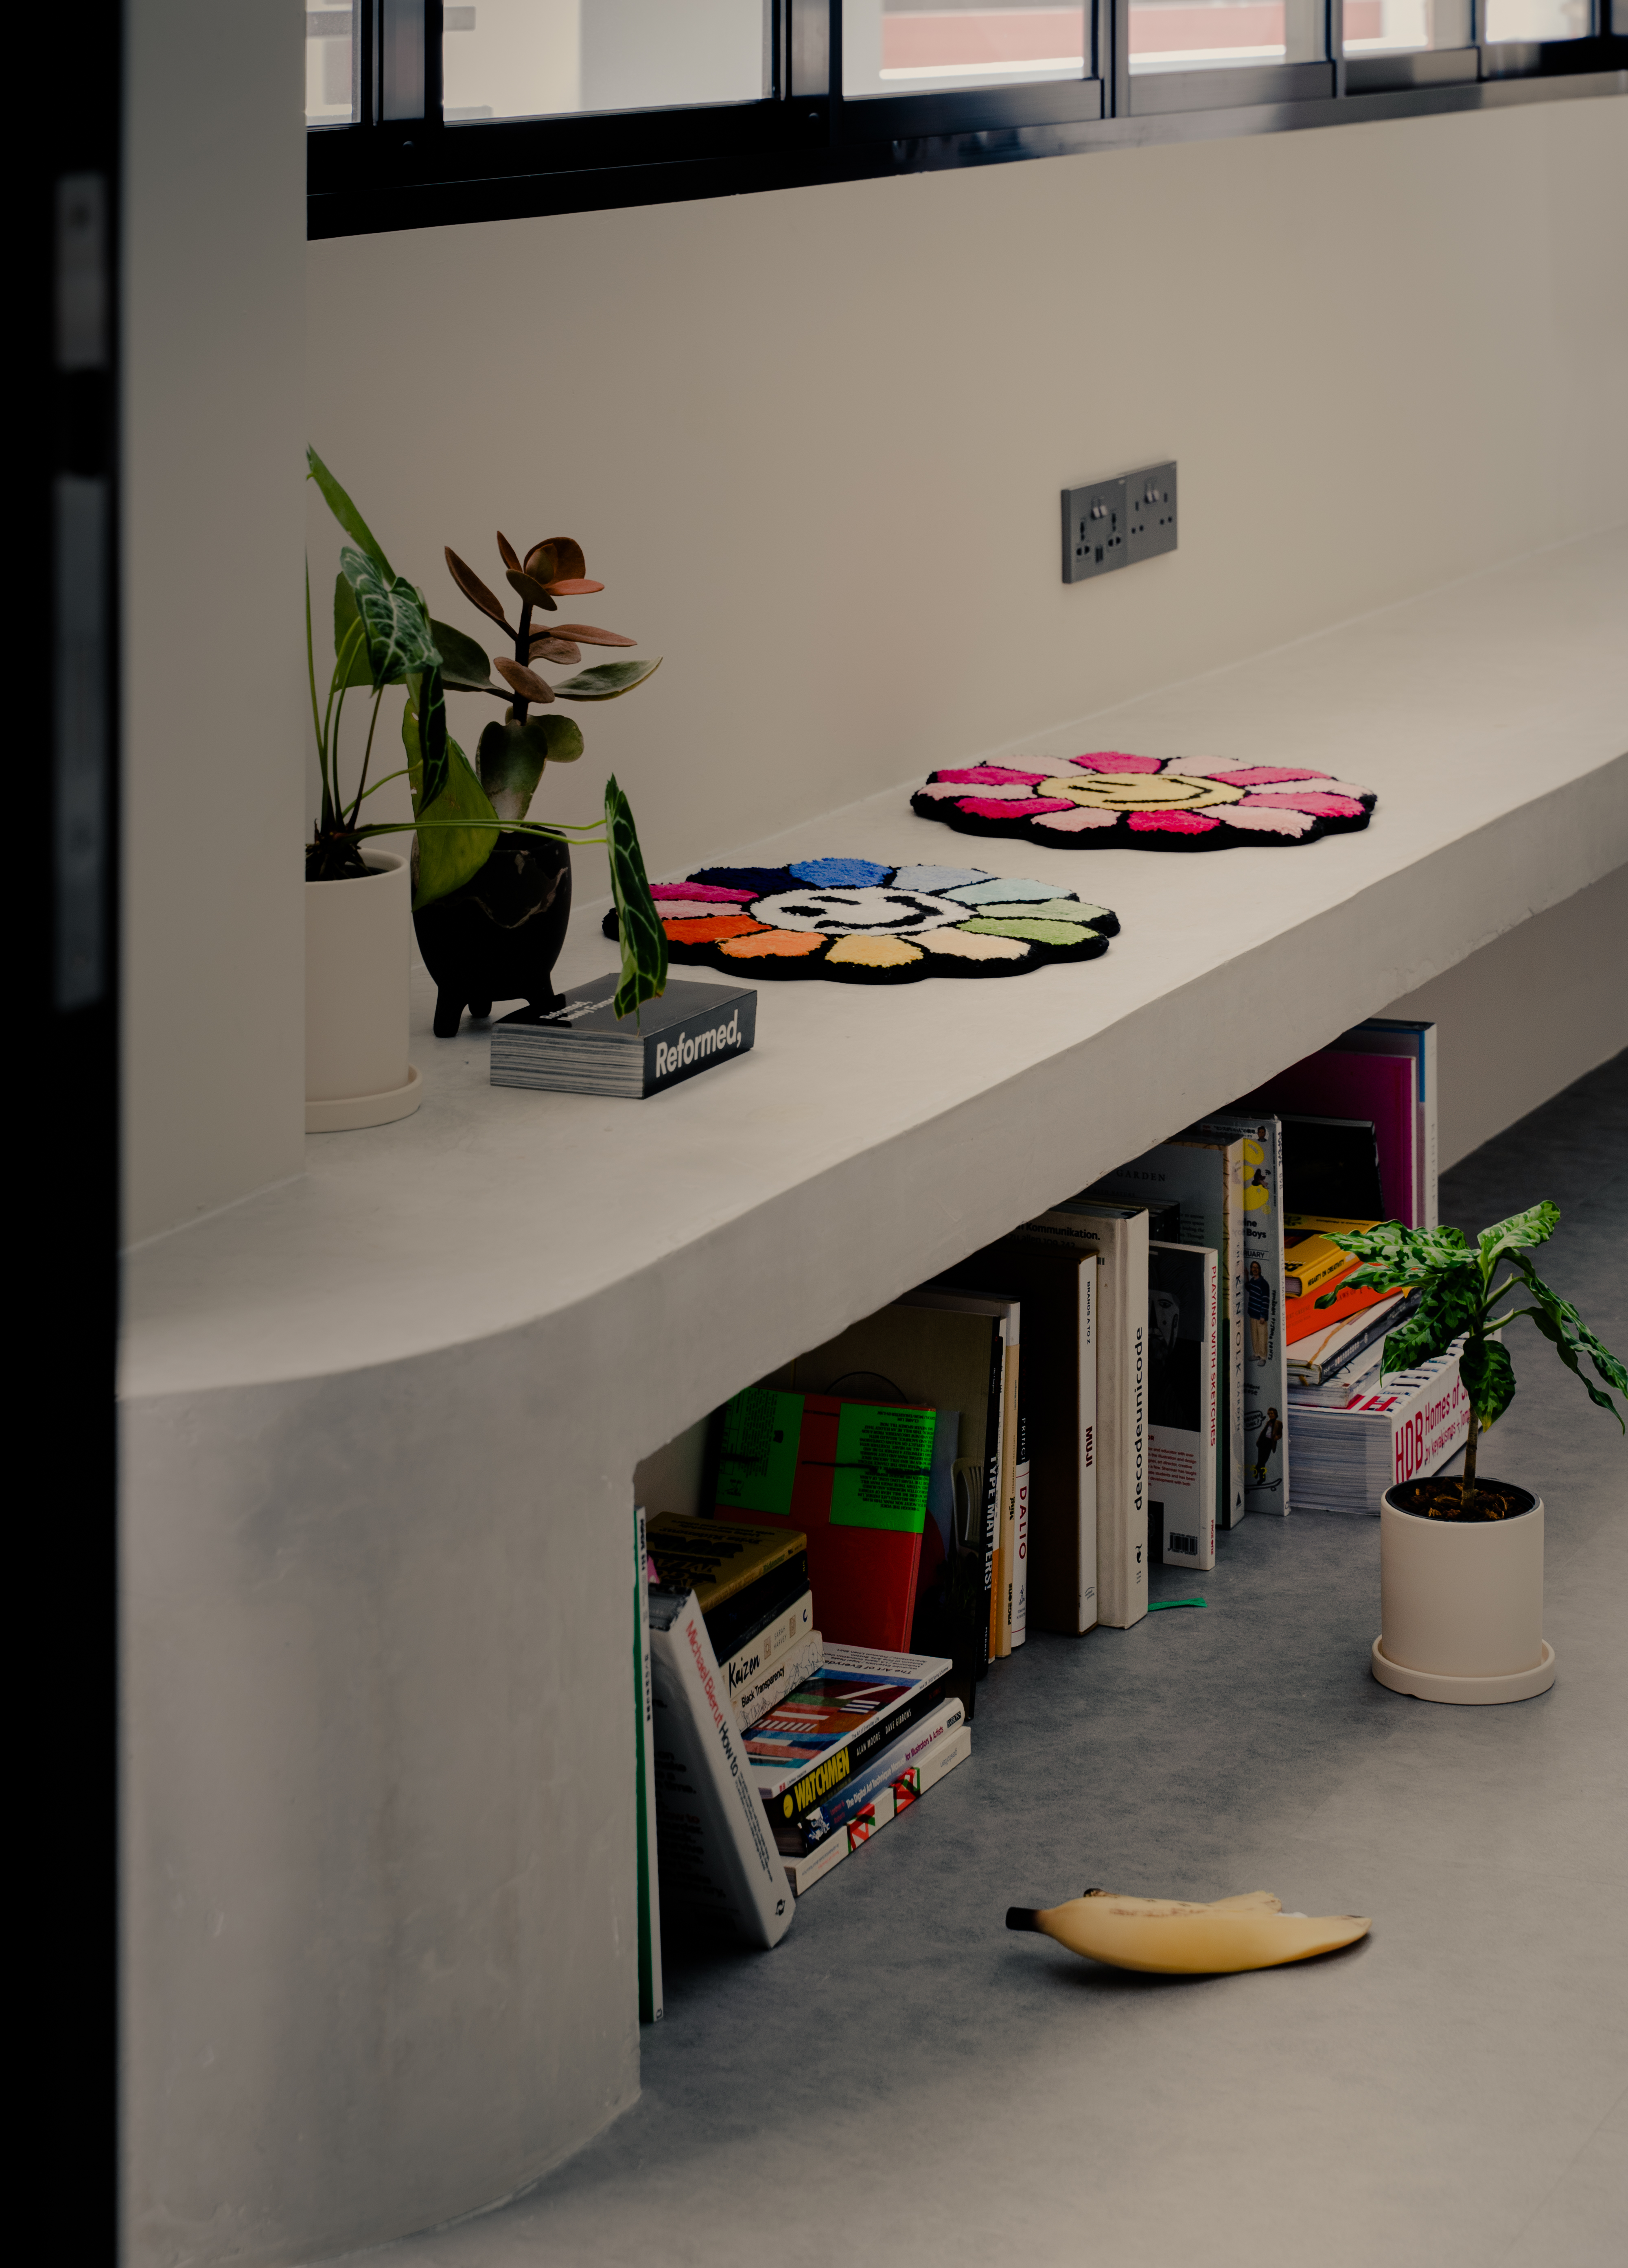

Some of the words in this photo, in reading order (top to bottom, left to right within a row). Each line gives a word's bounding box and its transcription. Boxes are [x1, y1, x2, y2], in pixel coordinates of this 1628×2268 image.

[656, 1010, 742, 1078] Reformed,
[1116, 1169, 1165, 1182] GARDEN
[1026, 1222, 1100, 1240] Kommunikation.
[1246, 1229, 1267, 1239] Boys
[1244, 1249, 1265, 1258] RUARY
[1308, 1271, 1321, 1286] HEGARTY
[1327, 1260, 1344, 1274] CREATIVITY
[1087, 1326, 1091, 1336] TO
[1134, 1327, 1143, 1511] decodeunicode
[1396, 1411, 1423, 1484] HDB
[1425, 1393, 1450, 1435] Homes
[1453, 1375, 1460, 1408] of
[988, 1456, 997, 1499] TYPE
[1019, 1487, 1027, 1559] DALIO
[985, 1505, 994, 1590] MATTERS!
[774, 1626, 786, 1640] SARAH
[774, 1634, 786, 1649] HARVEY
[729, 1655, 760, 1698] Kaizen
[823, 1659, 863, 1668] Everyda
[686, 1620, 710, 1682] Michael
[705, 1675, 724, 1728] Bierut
[719, 1721, 734, 1760] How
[731, 1755, 738, 1776] to
[741, 1692, 755, 1708] Black
[755, 1666, 785, 1696] Transparency
[864, 1720, 874, 1732] Everyday
[794, 1745, 850, 1812] WATCHMEN
[857, 1743, 867, 1757] ALAN
[867, 1731, 880, 1748] MOORE
[885, 1721, 895, 1735] DAVE
[896, 1708, 912, 1727] GIBBONS
[846, 1798, 854, 1809] The
[853, 1789, 867, 1803] Digital
[871, 1770, 892, 1790] Technique
[910, 1738, 929, 1757] Illustrators
[929, 1734, 932, 1742] &
[933, 1726, 944, 1740] Artists
